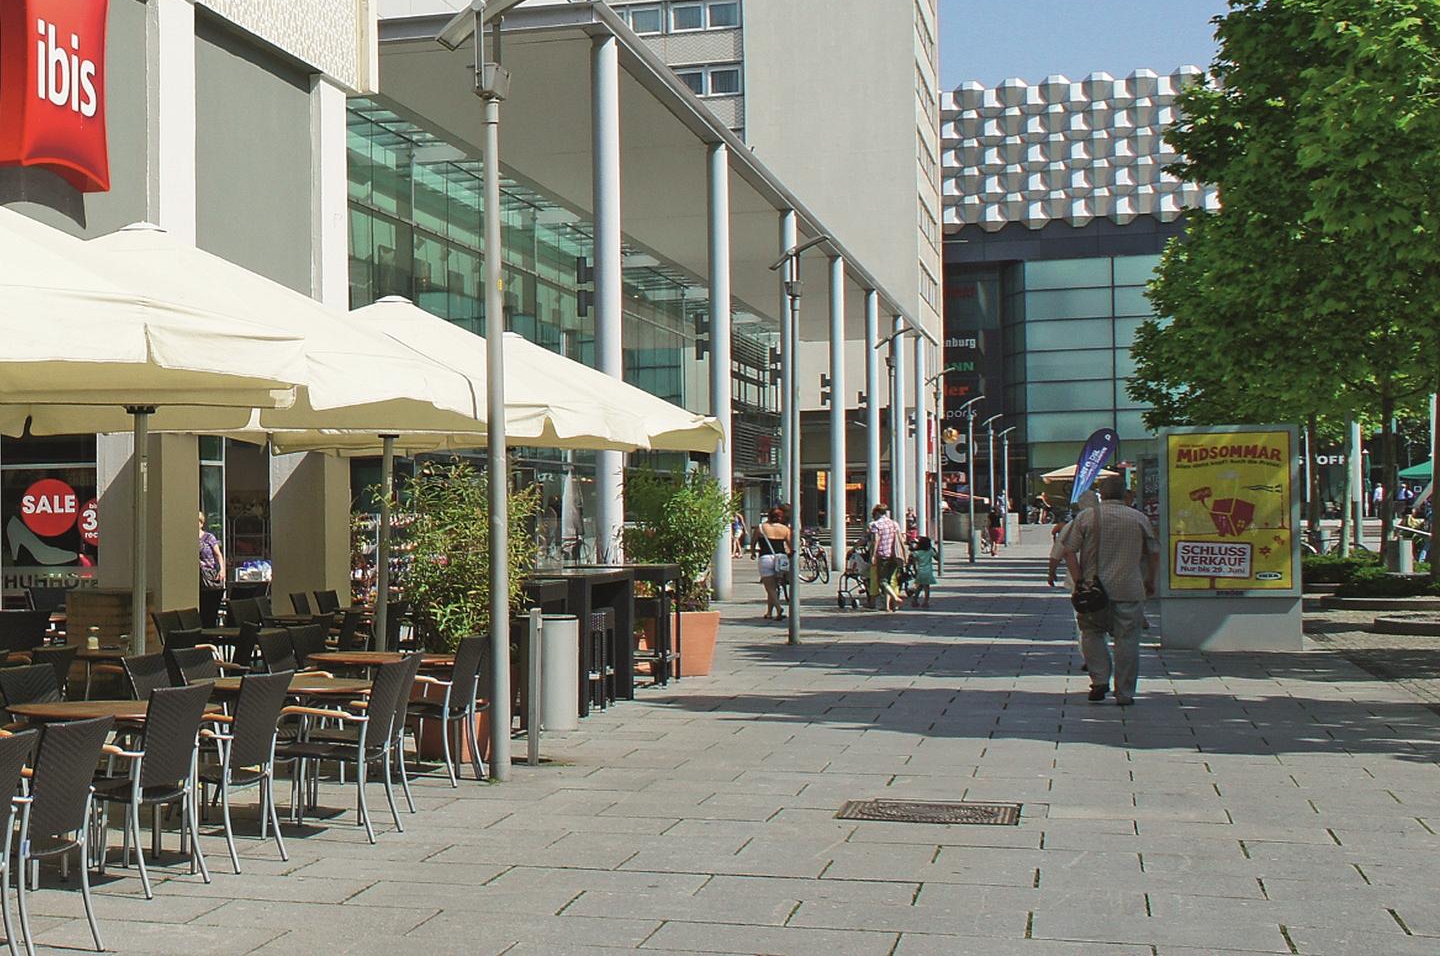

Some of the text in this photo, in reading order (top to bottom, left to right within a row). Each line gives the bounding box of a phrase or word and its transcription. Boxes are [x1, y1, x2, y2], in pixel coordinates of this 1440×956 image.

[36, 18, 97, 117] ibis
[1176, 444, 1282, 463] MIDSOMMAR
[22, 495, 76, 514] SALE
[1180, 545, 1248, 556] SCHLUSS
[1180, 555, 1247, 566] VERKAUF
[1198, 565, 1211, 573] bis
[1227, 566, 1246, 574] Juni
